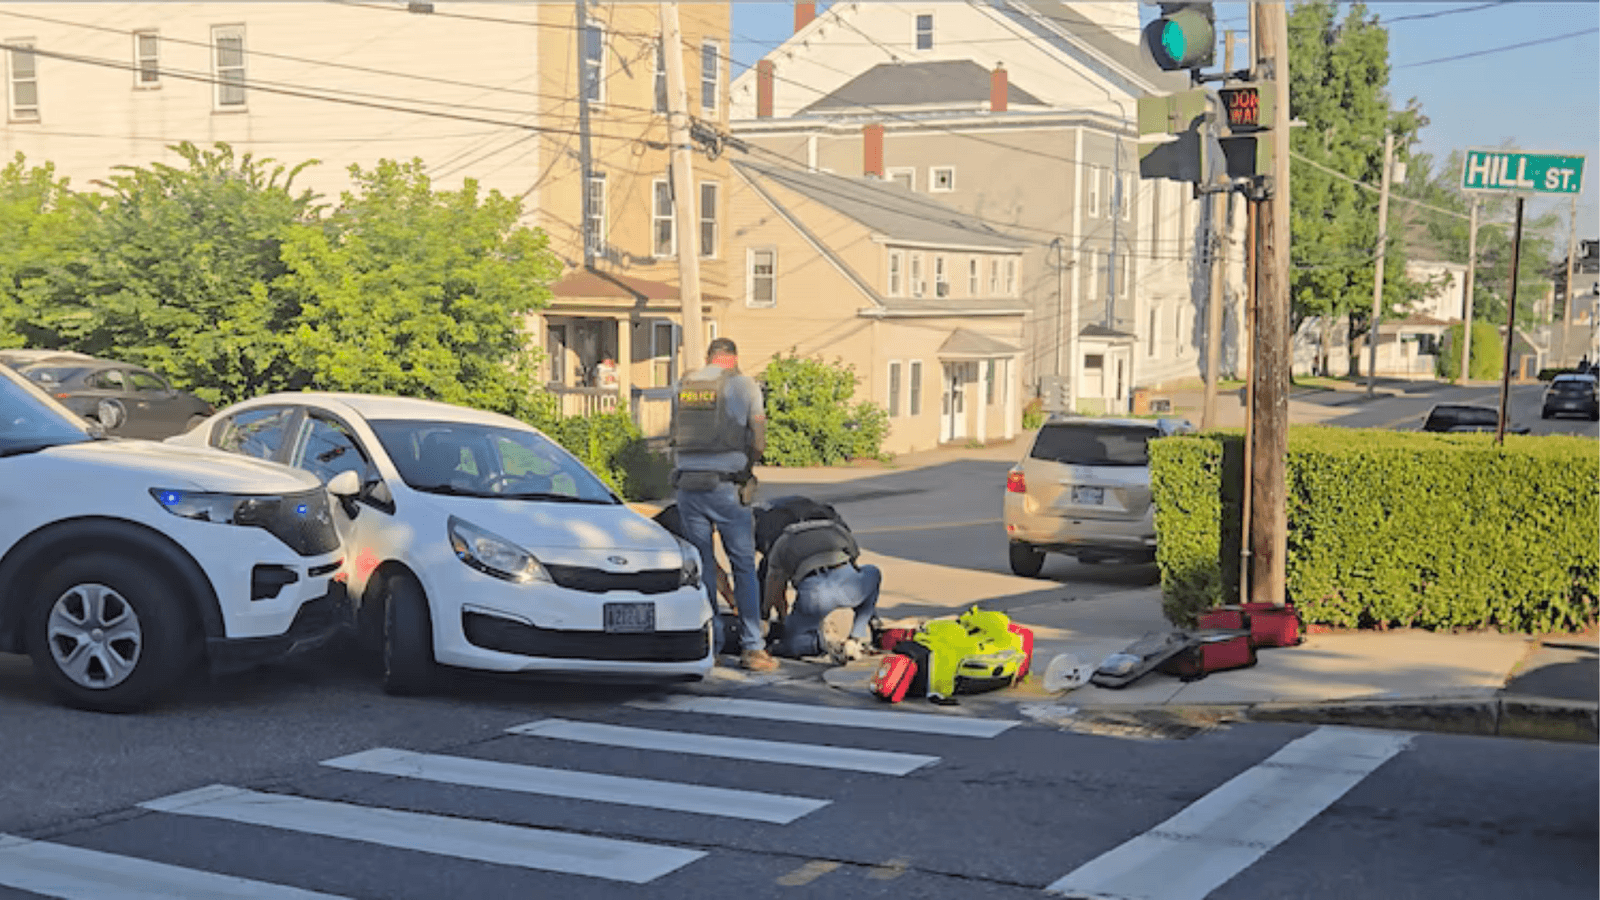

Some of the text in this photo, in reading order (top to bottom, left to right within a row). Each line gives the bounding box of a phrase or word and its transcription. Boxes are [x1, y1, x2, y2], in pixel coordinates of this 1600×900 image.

[1467, 155, 1577, 189] HILL ST.
[680, 390, 716, 401] POLICE
